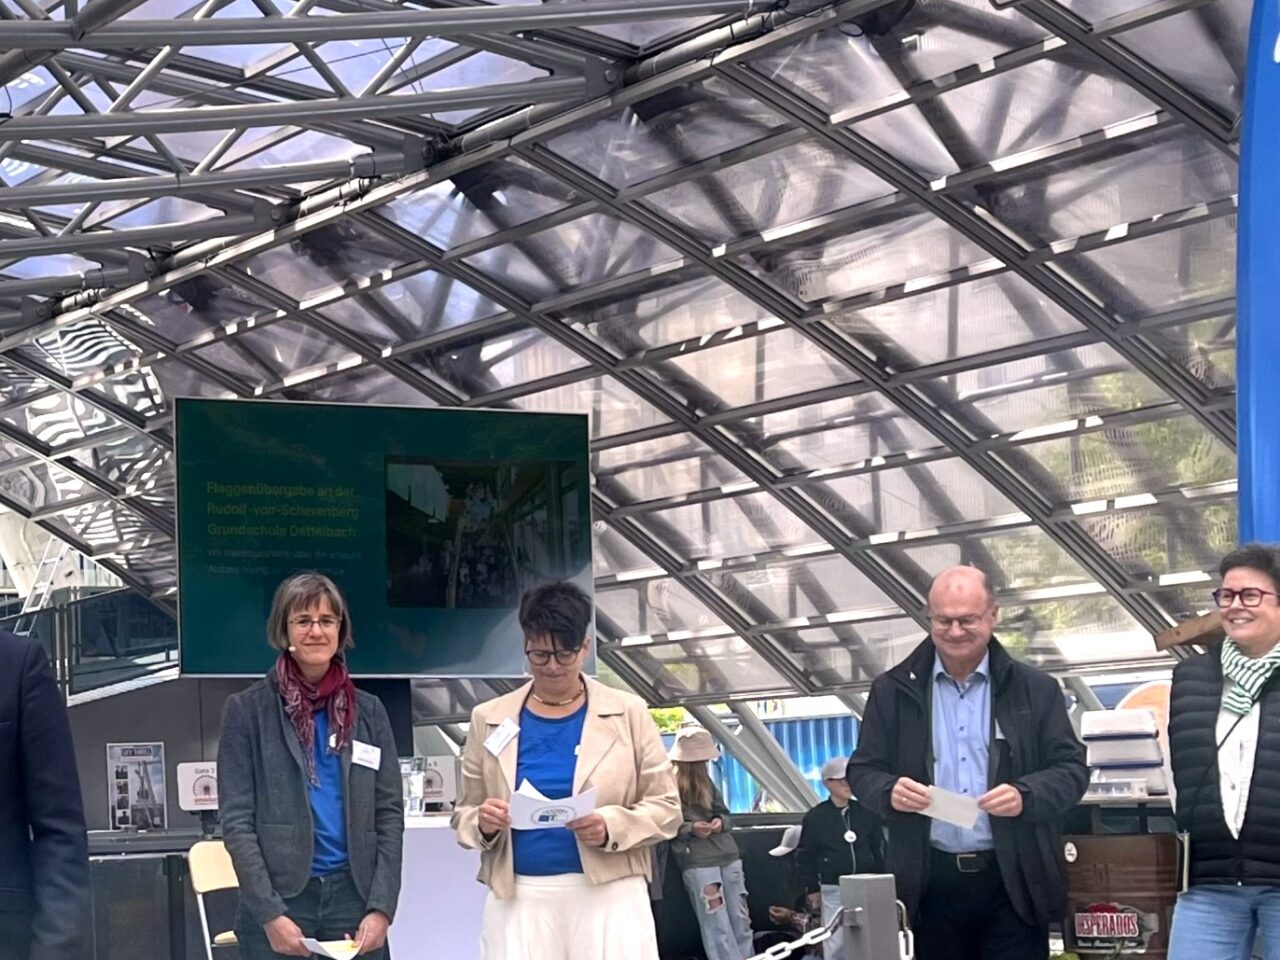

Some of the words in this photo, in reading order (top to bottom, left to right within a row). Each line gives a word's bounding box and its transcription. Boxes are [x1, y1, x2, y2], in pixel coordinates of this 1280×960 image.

[206, 481, 314, 499] Flaggenübergabe
[207, 522, 287, 538] Grundschule
[289, 524, 357, 539] Dettelbach
[1075, 913, 1139, 937] DESPERADOS
